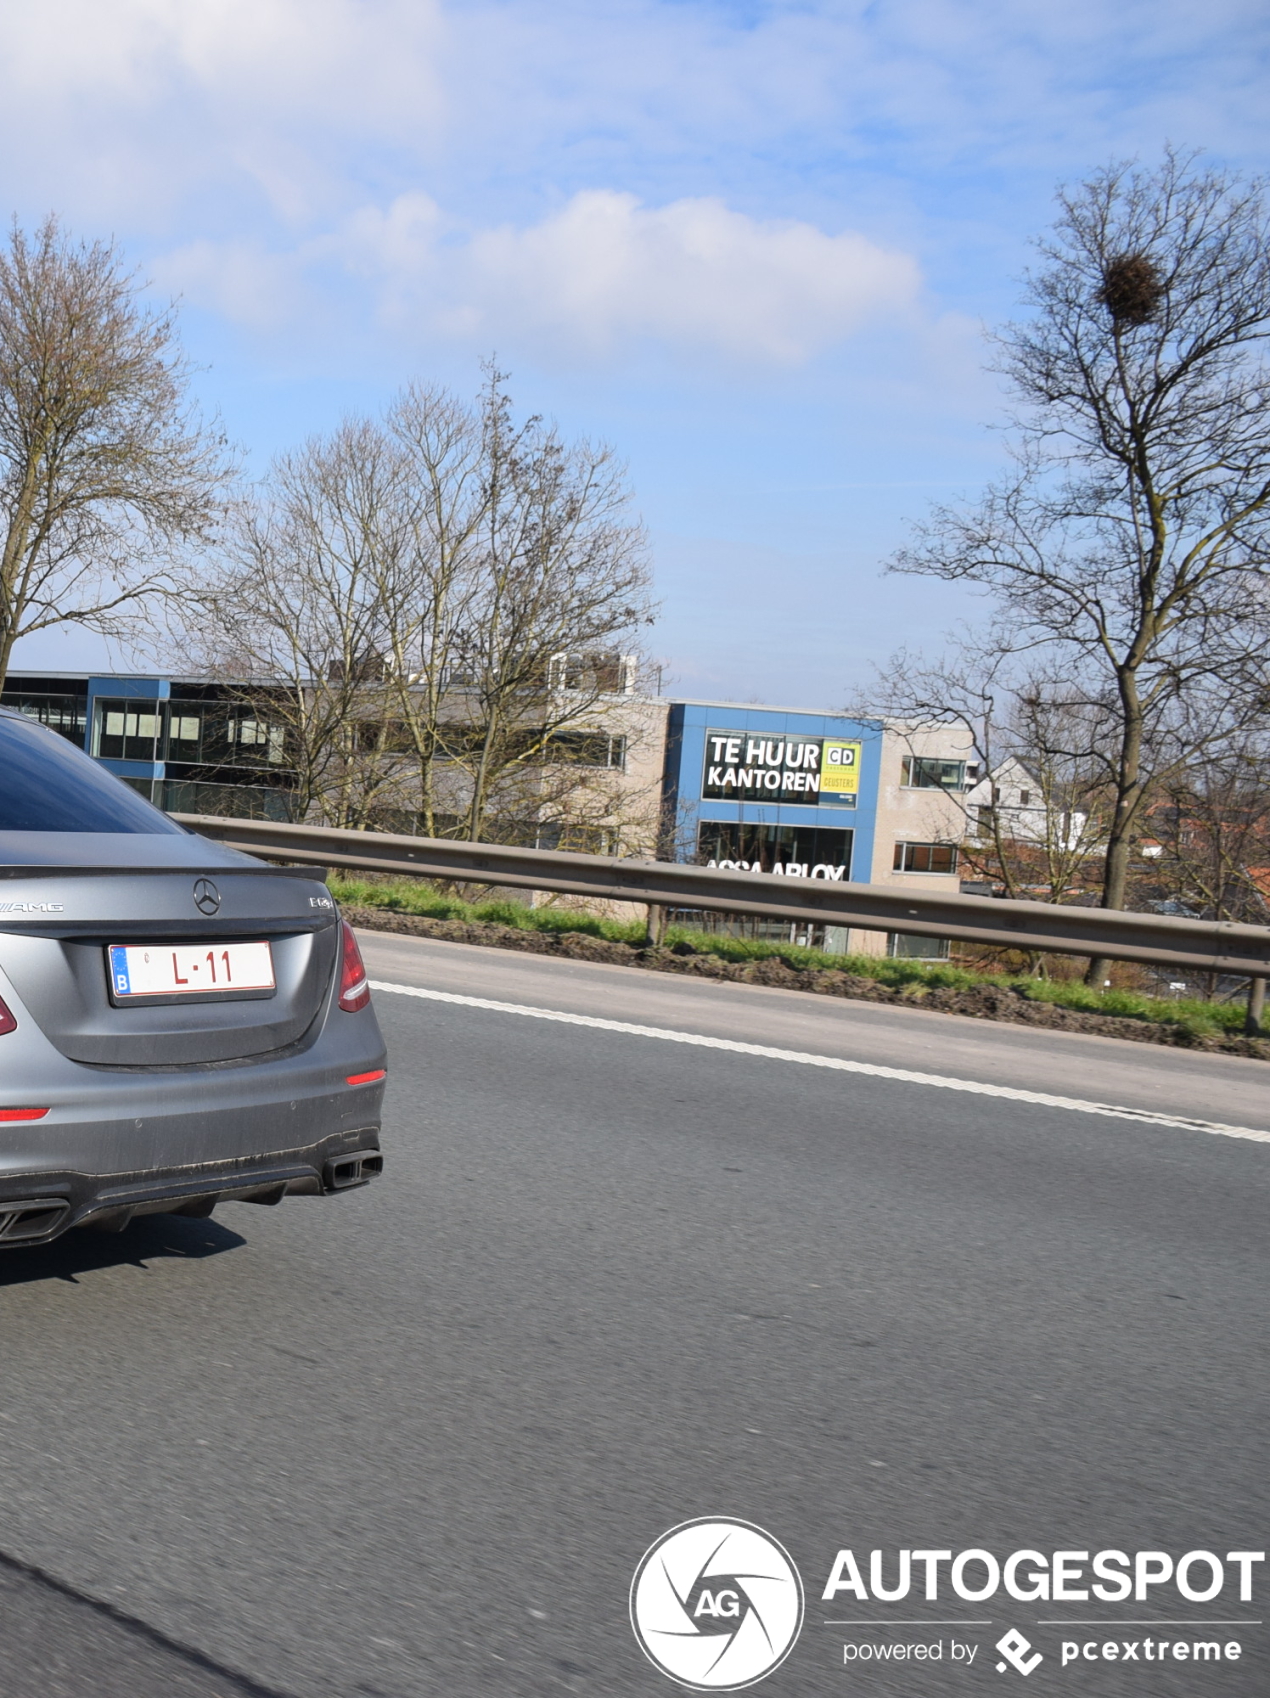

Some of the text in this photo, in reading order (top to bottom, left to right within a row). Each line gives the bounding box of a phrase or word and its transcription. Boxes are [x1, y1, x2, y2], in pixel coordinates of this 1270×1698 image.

[711, 737, 819, 769] TE HUUR
[708, 766, 820, 792] KANTOREN
[10, 902, 64, 913] AMG
[117, 975, 128, 990] B
